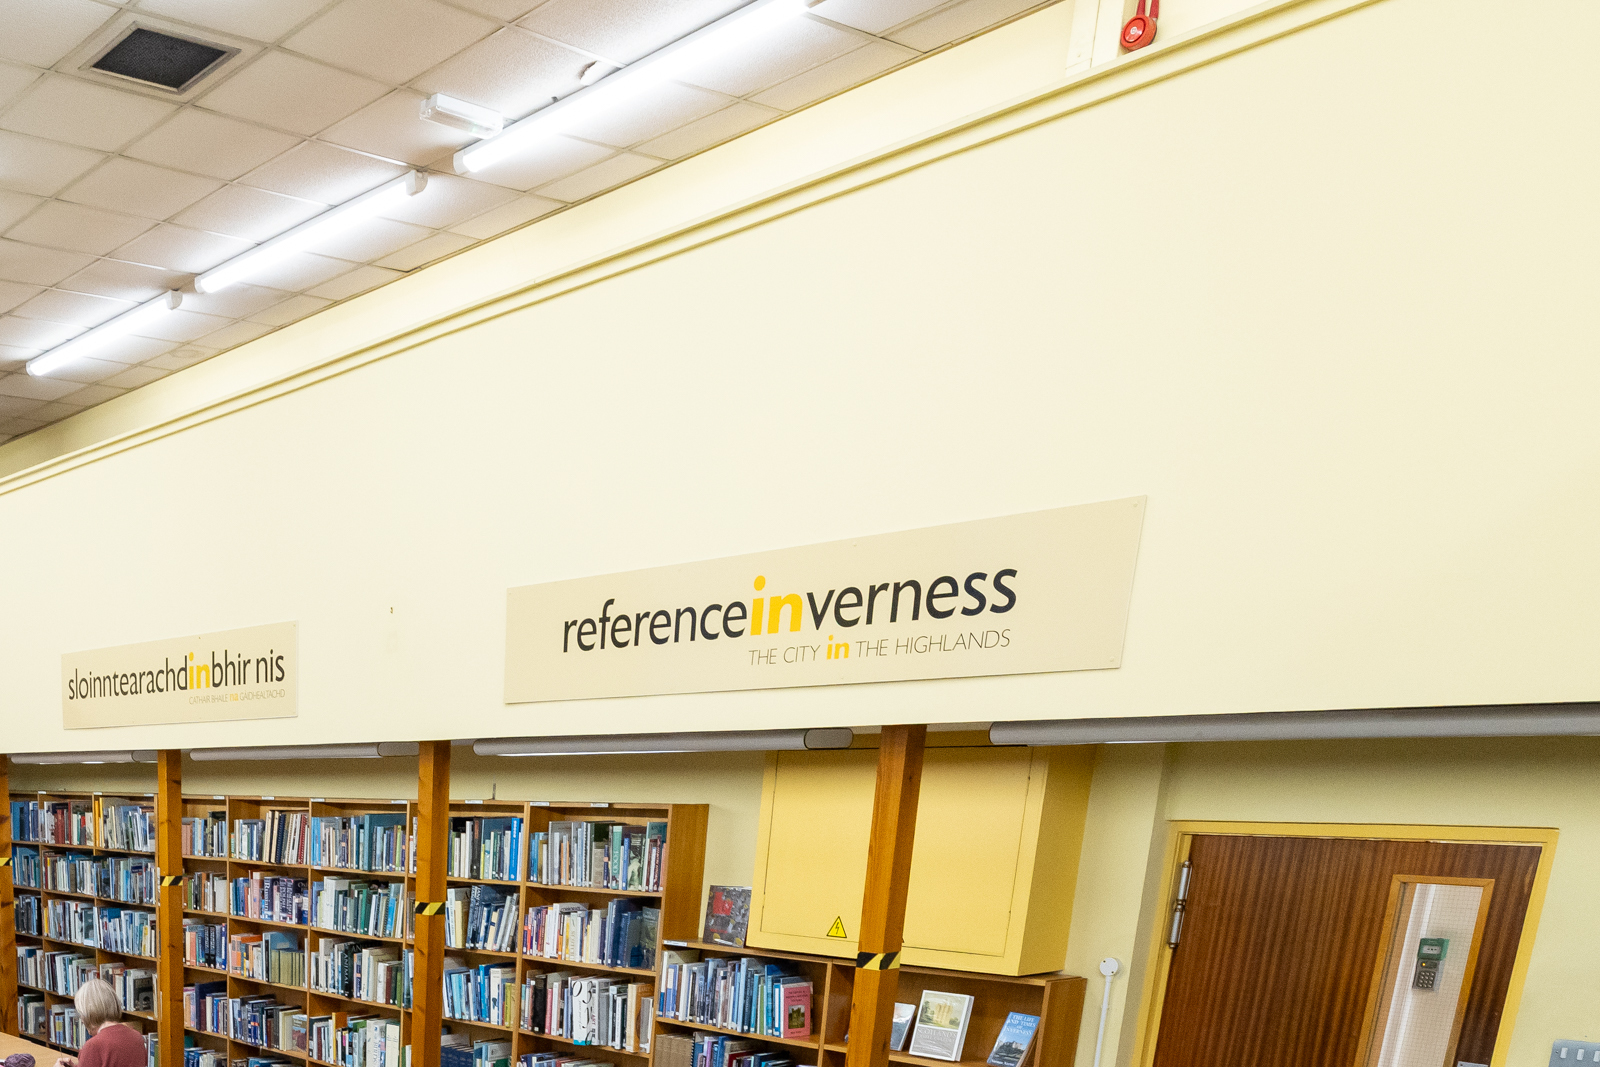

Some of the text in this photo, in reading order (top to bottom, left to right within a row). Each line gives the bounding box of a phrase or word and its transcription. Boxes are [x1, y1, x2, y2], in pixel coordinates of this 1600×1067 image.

[749, 628, 1011, 666] THE CITY in THE HIGHLANDS
[229, 693, 239, 702] na
